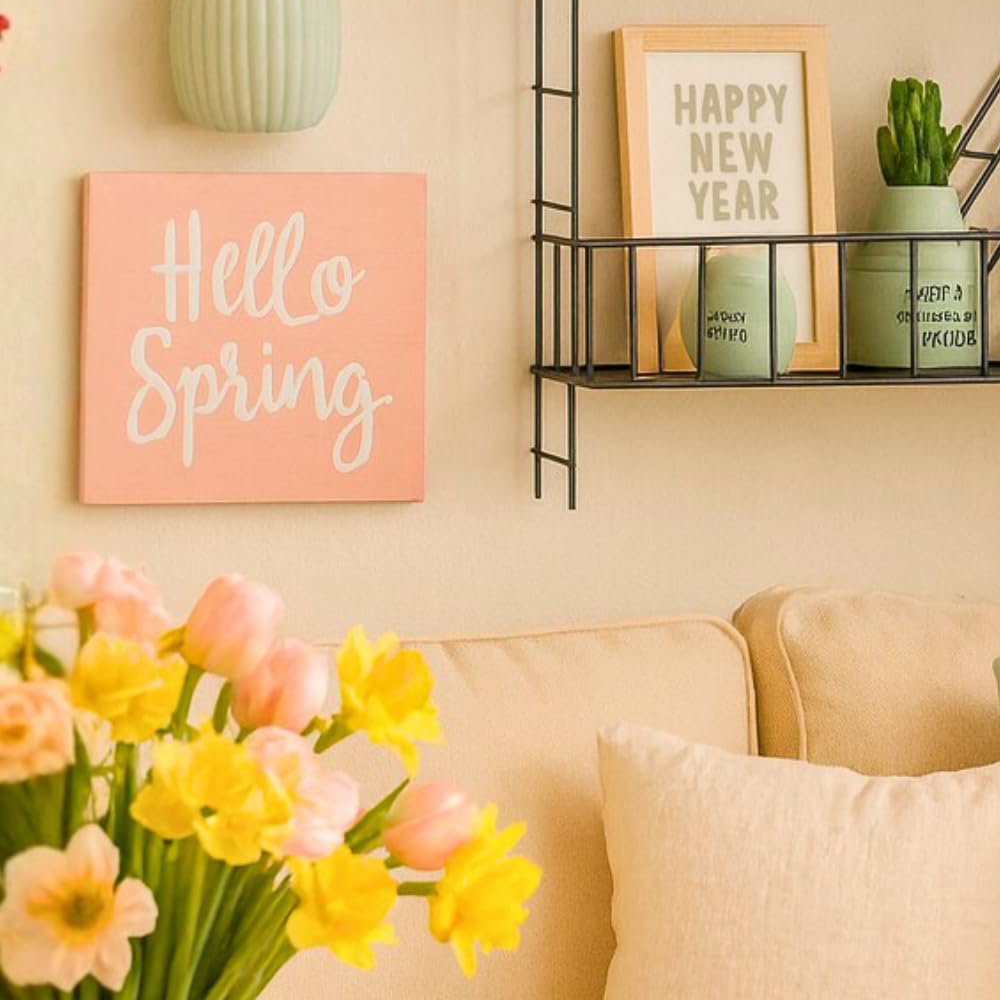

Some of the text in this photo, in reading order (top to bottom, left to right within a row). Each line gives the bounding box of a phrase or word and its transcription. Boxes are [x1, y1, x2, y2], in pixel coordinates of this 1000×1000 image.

[674, 83, 788, 126] HAPPY
[690, 131, 773, 174] NEW
[688, 179, 779, 221] YEAR
[151, 209, 367, 326] Hello
[127, 326, 393, 473] Spring
